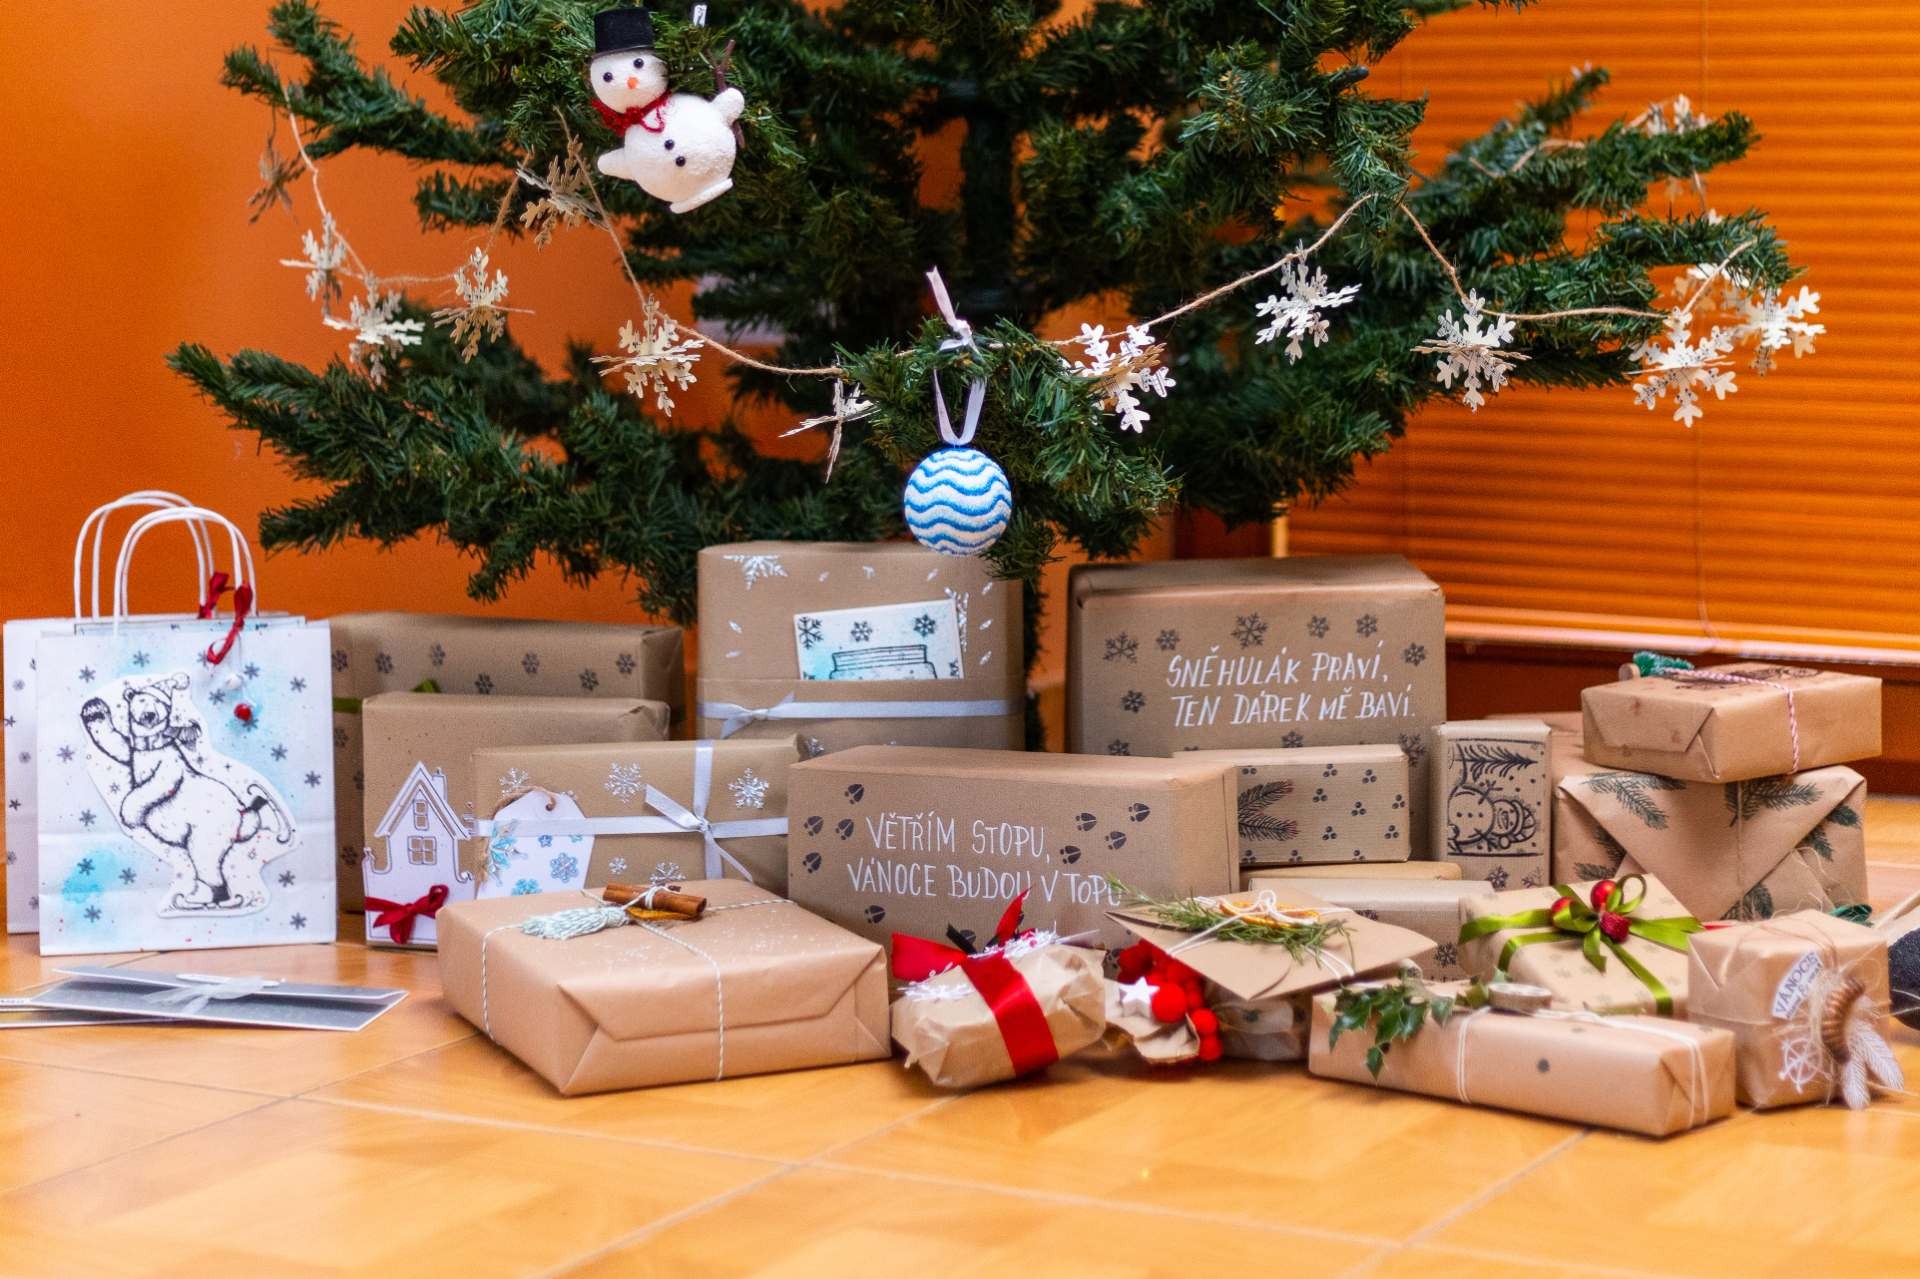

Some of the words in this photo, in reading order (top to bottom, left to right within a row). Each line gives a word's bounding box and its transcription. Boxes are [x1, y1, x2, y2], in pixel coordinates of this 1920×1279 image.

[1166, 646, 1301, 688] SNĚHULÁK
[1311, 640, 1388, 684] PRAVÍ,
[1171, 695, 1222, 727] TEN
[1230, 690, 1312, 725] DÁREK
[1319, 687, 1353, 721] MĚ
[1355, 684, 1416, 719] BAVÍ.
[866, 809, 956, 853] VĚTŘÍM
[971, 820, 1051, 864] STOPU,
[847, 857, 937, 897] VÁNOCE
[946, 863, 1031, 901] BUDOU
[1039, 869, 1059, 902] V
